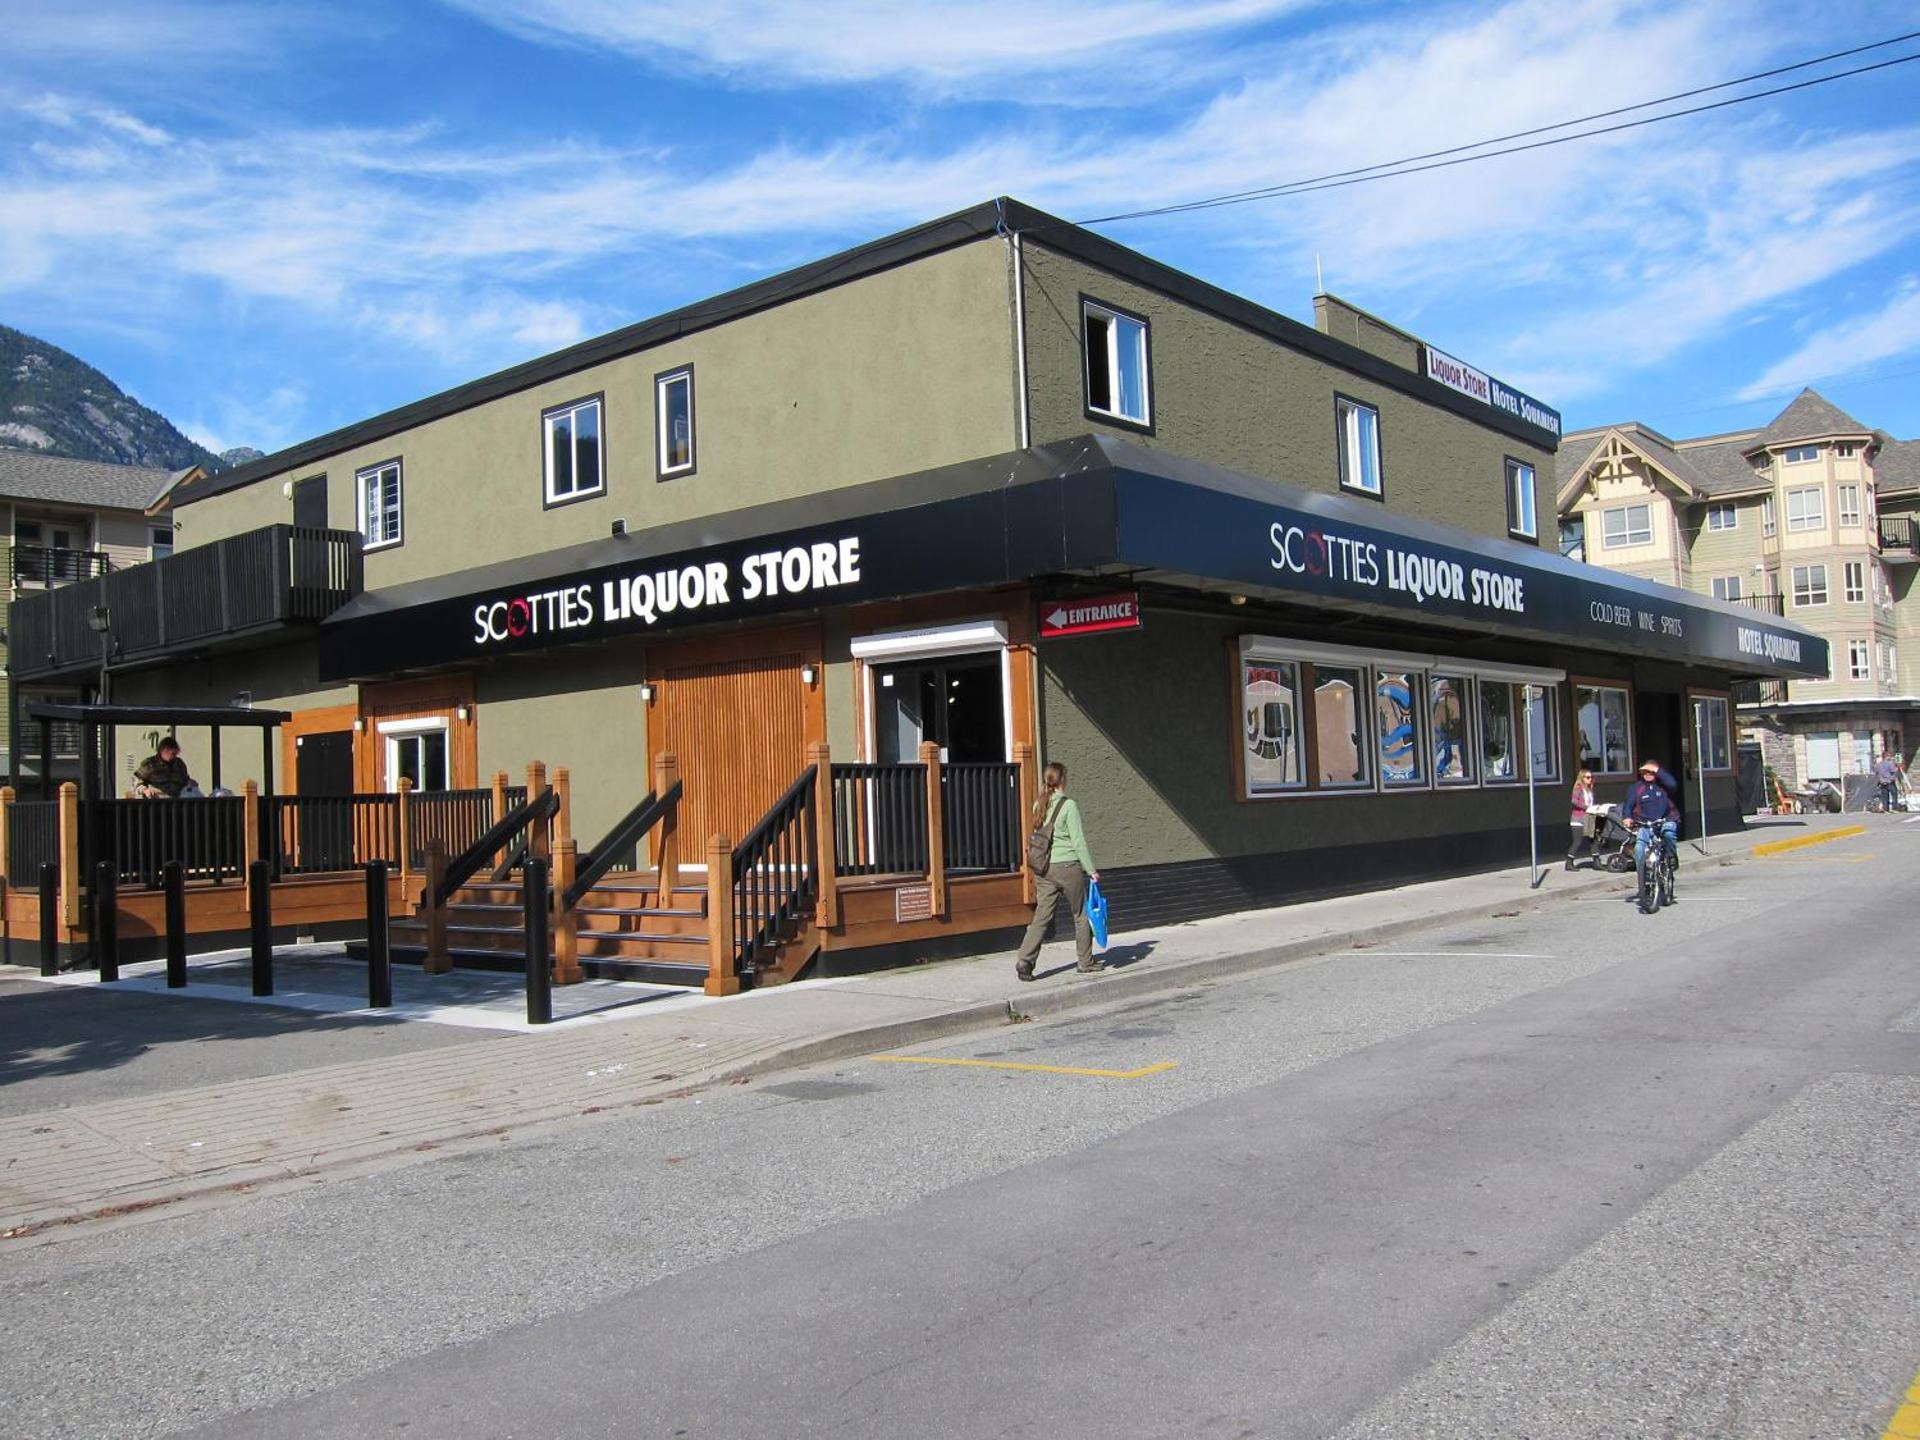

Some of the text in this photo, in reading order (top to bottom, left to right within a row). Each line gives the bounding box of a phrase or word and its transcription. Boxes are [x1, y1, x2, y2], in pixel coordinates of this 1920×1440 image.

[1430, 351, 1487, 399] LIQUOR STORE
[1492, 382, 1559, 435] HOTEL SQUAMISH
[474, 536, 861, 644] SCOTTIES LIQUOR STORE
[1270, 522, 1525, 613] SCOTTIES LIQUOR STORE
[1069, 602, 1132, 624] ENTRANCE
[1590, 601, 1682, 637] COLD BEER WINE SPIRITS
[1738, 626, 1763, 655] HOTEL
